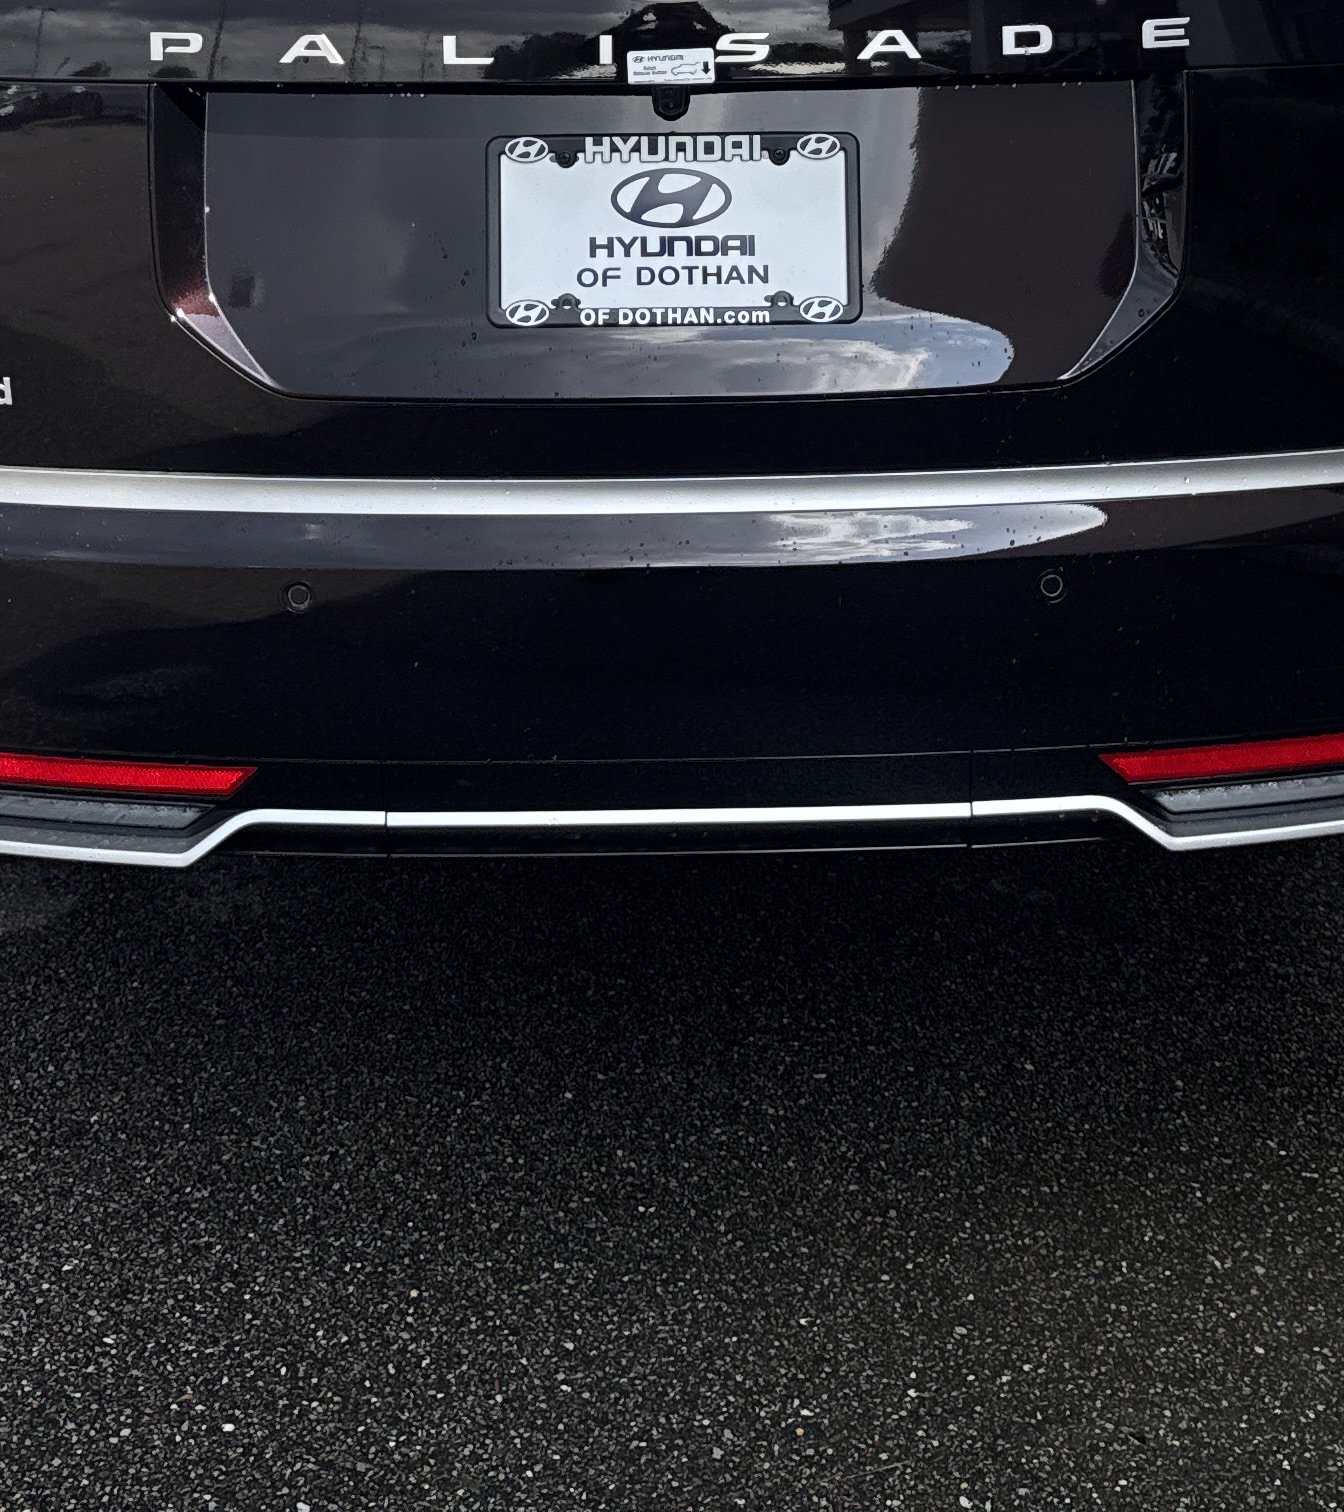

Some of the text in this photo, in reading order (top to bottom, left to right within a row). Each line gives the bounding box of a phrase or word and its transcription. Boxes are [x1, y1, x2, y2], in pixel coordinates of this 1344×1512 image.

[149, 16, 1191, 66] PALISADE
[584, 134, 761, 163] HYUNDAI
[588, 234, 756, 258] HYUNDAI
[576, 264, 769, 288] OF DOTHAN
[580, 306, 771, 326] OF DOTHAN.com
